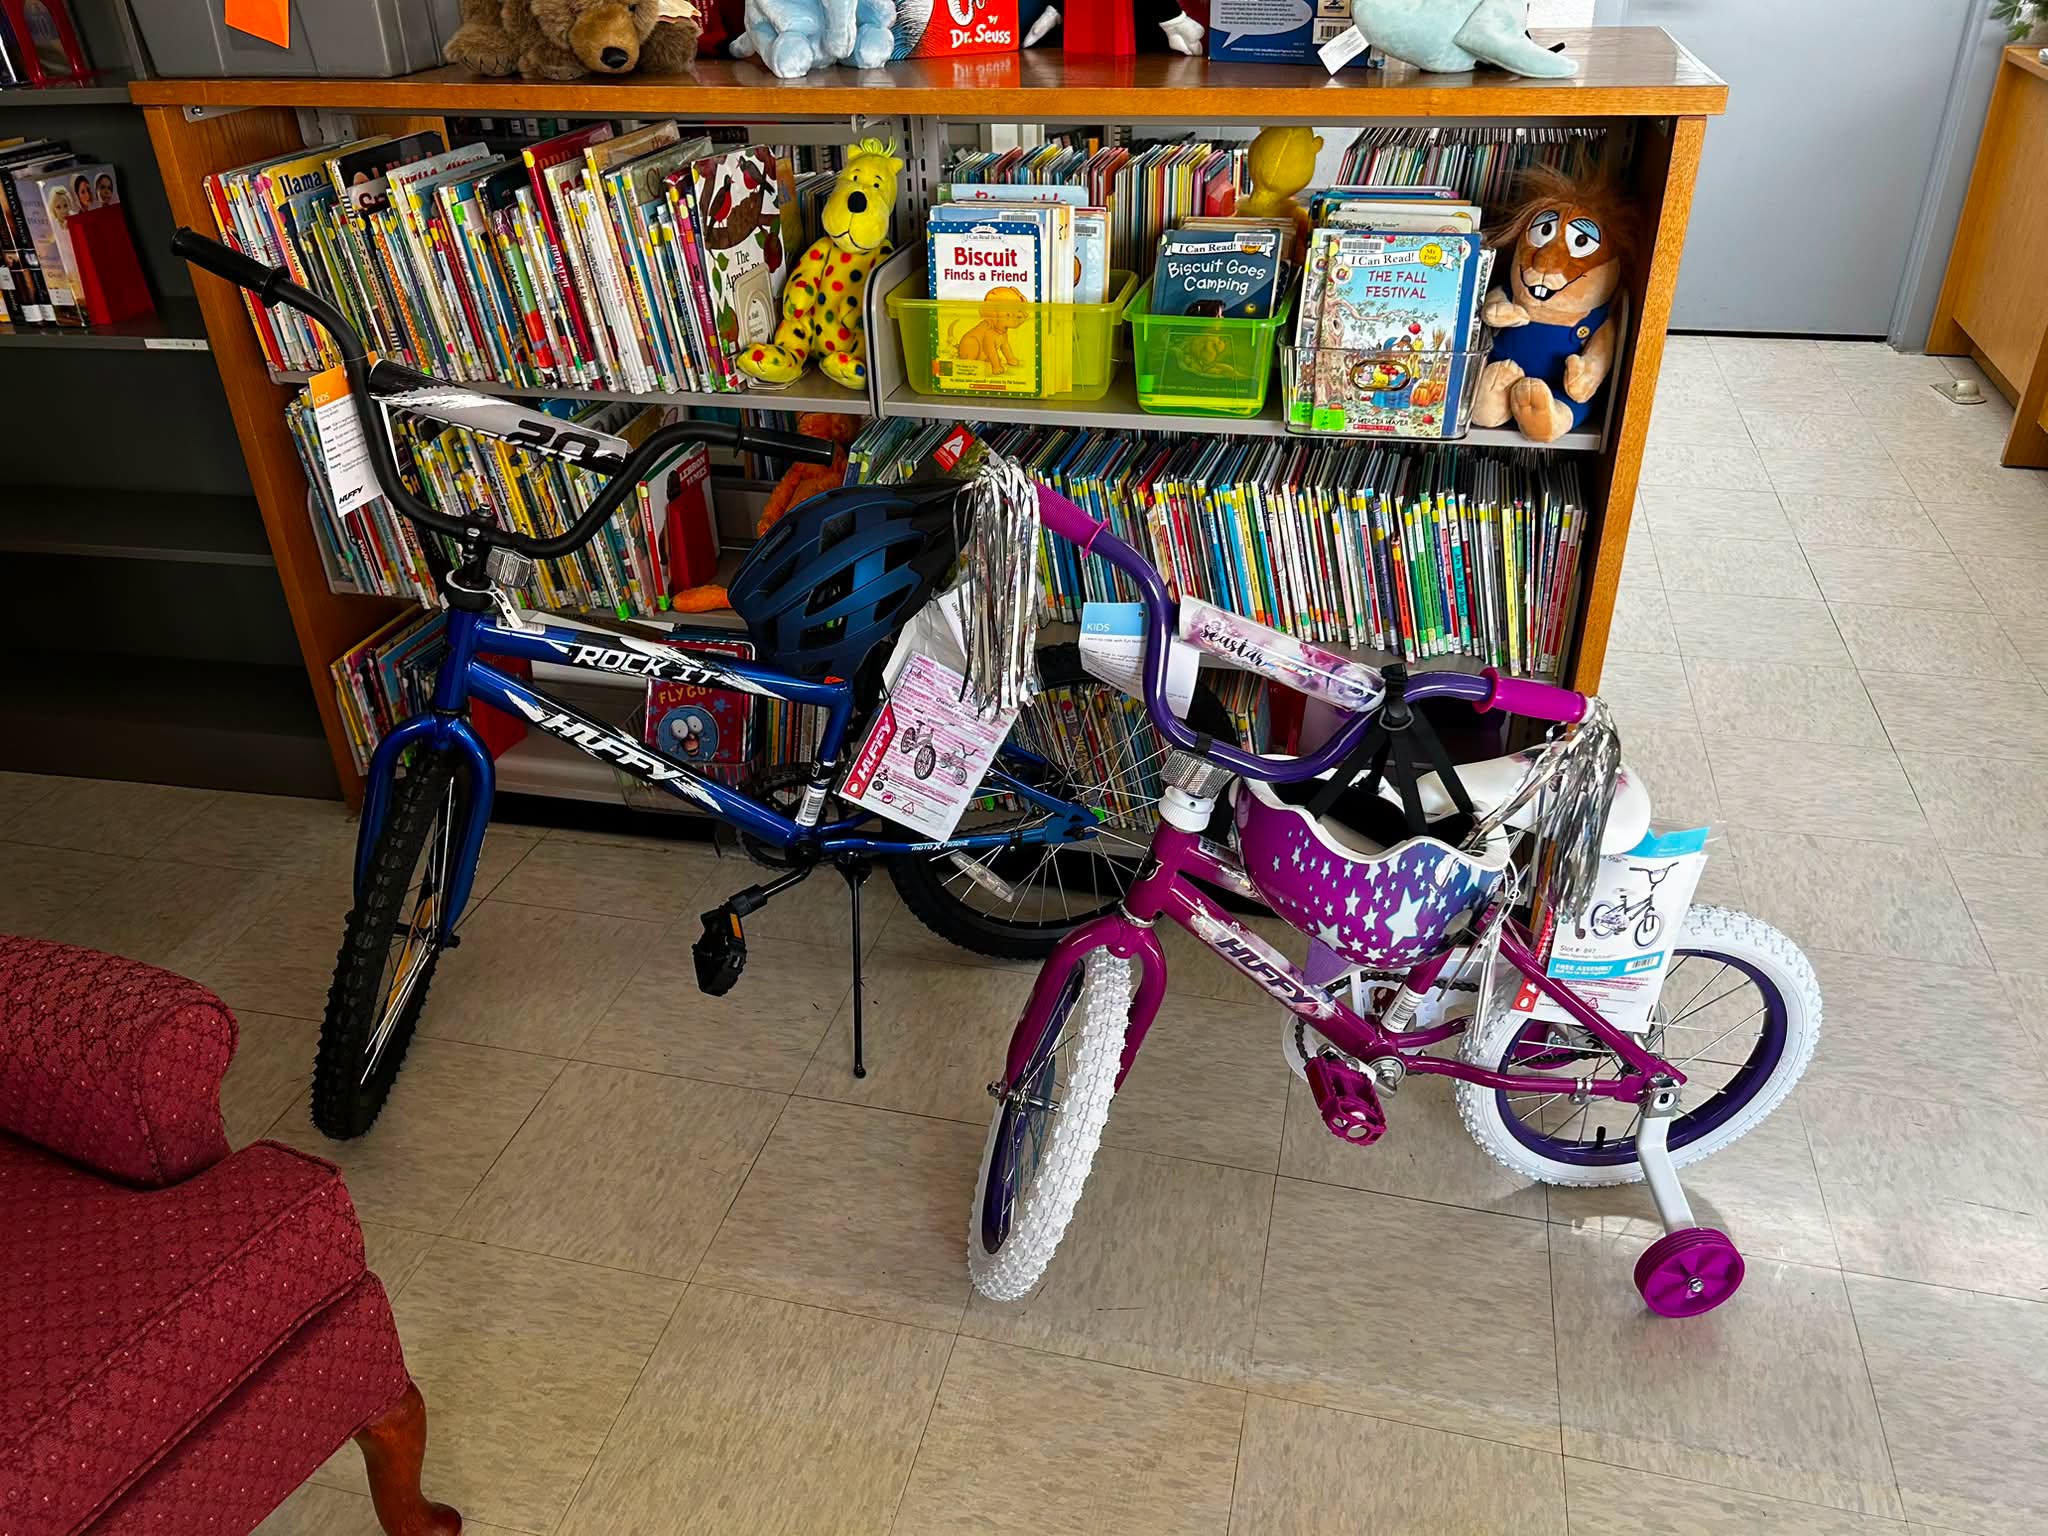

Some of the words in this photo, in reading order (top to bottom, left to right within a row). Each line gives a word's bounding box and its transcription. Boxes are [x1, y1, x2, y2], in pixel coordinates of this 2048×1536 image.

[950, 29, 972, 48] Dr.
[974, 24, 1010, 44] Seuss
[279, 170, 324, 197] llama
[736, 250, 750, 265] The
[954, 247, 1018, 267] Biscuit
[1179, 245, 1184, 253] I
[1186, 245, 1206, 253] Can
[1208, 243, 1236, 252] Read!
[551, 244, 570, 289] RRRALPH
[1168, 258, 1223, 278] Biscuit
[1226, 259, 1266, 280] Goes
[1351, 257, 1356, 265] I
[1358, 256, 1380, 266] Can
[1384, 253, 1414, 264] Read!
[944, 268, 975, 282] Finds
[979, 272, 986, 281] a
[991, 270, 1028, 282] Friend
[1368, 270, 1392, 282] THE
[1398, 271, 1428, 284] FALL
[1184, 276, 1249, 296] Camping
[1366, 286, 1426, 299] FESTIVAL
[316, 392, 330, 404] KIDS
[1357, 418, 1384, 426] MERCER
[1385, 418, 1408, 426] MAYER
[504, 419, 600, 462] 20
[679, 454, 705, 481] LEBRON
[338, 485, 364, 505] HUFFY
[1454, 552, 1462, 566] Are
[1455, 566, 1463, 579] You
[1086, 623, 1110, 632] KIDS
[1200, 623, 1266, 668] seastar
[572, 645, 670, 676] ROCK
[672, 664, 721, 684] IT
[543, 713, 685, 780] HUFFY
[857, 716, 892, 782] HUFFY
[1216, 937, 1319, 1004] HUFFY
